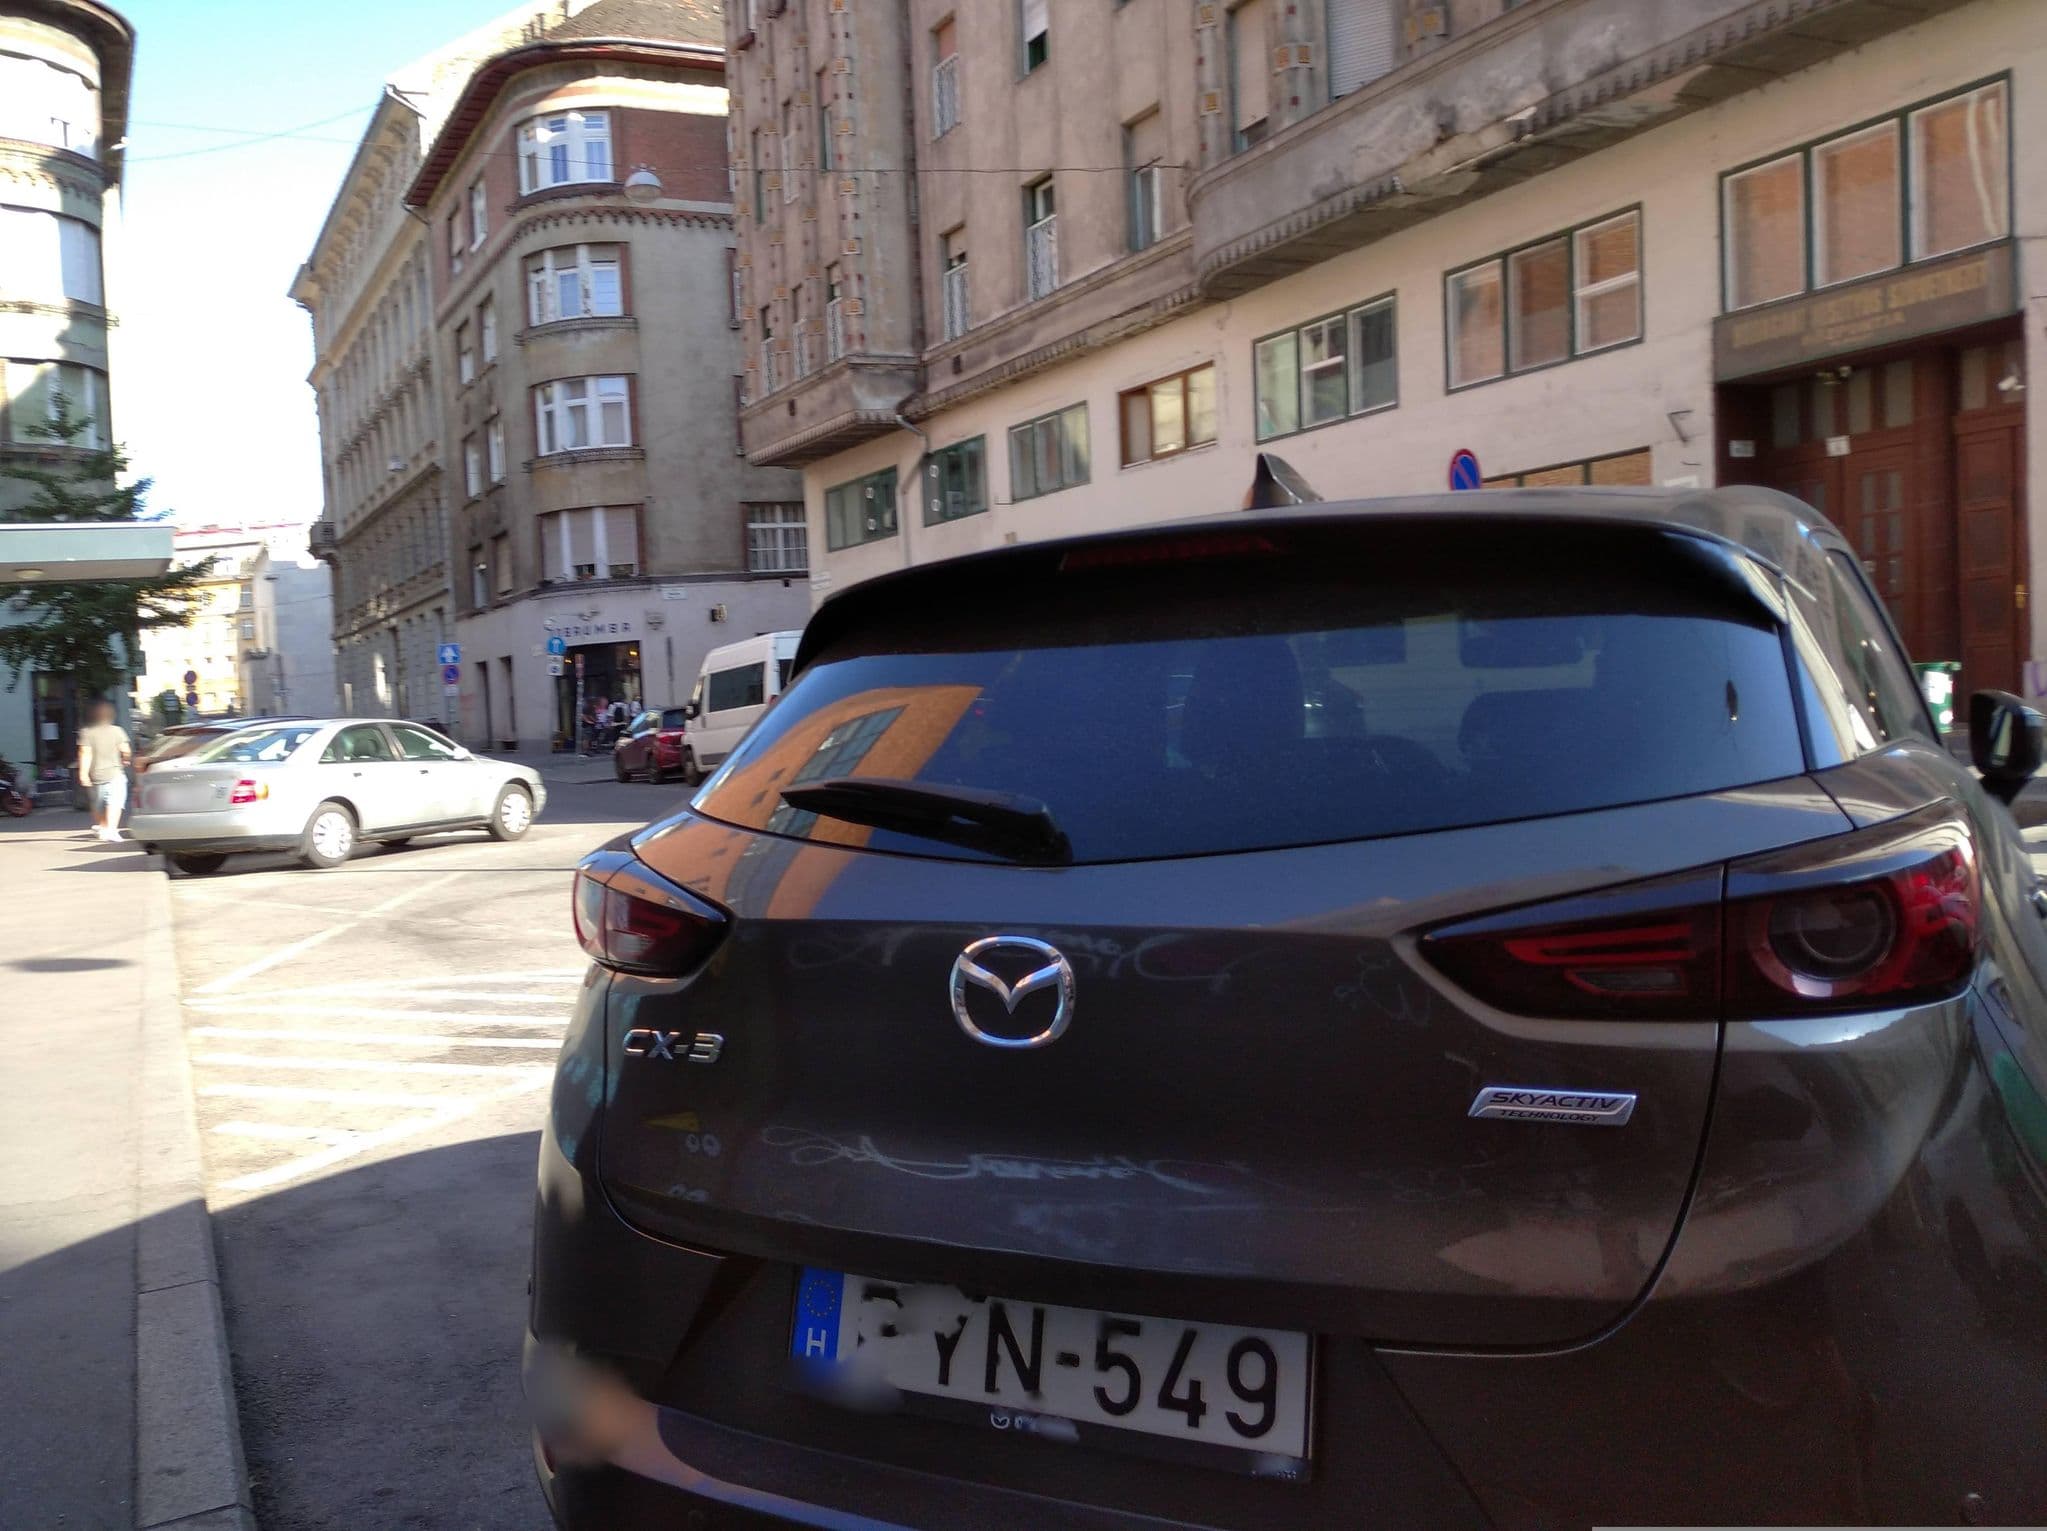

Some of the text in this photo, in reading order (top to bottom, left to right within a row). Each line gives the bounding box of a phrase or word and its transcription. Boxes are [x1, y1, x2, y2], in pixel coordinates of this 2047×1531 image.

[622, 1029, 726, 1064] CX-3
[1490, 1092, 1620, 1109] SKYACTIV
[1499, 1110, 1600, 1122] TECHNOLOGY
[805, 1327, 828, 1358] H
